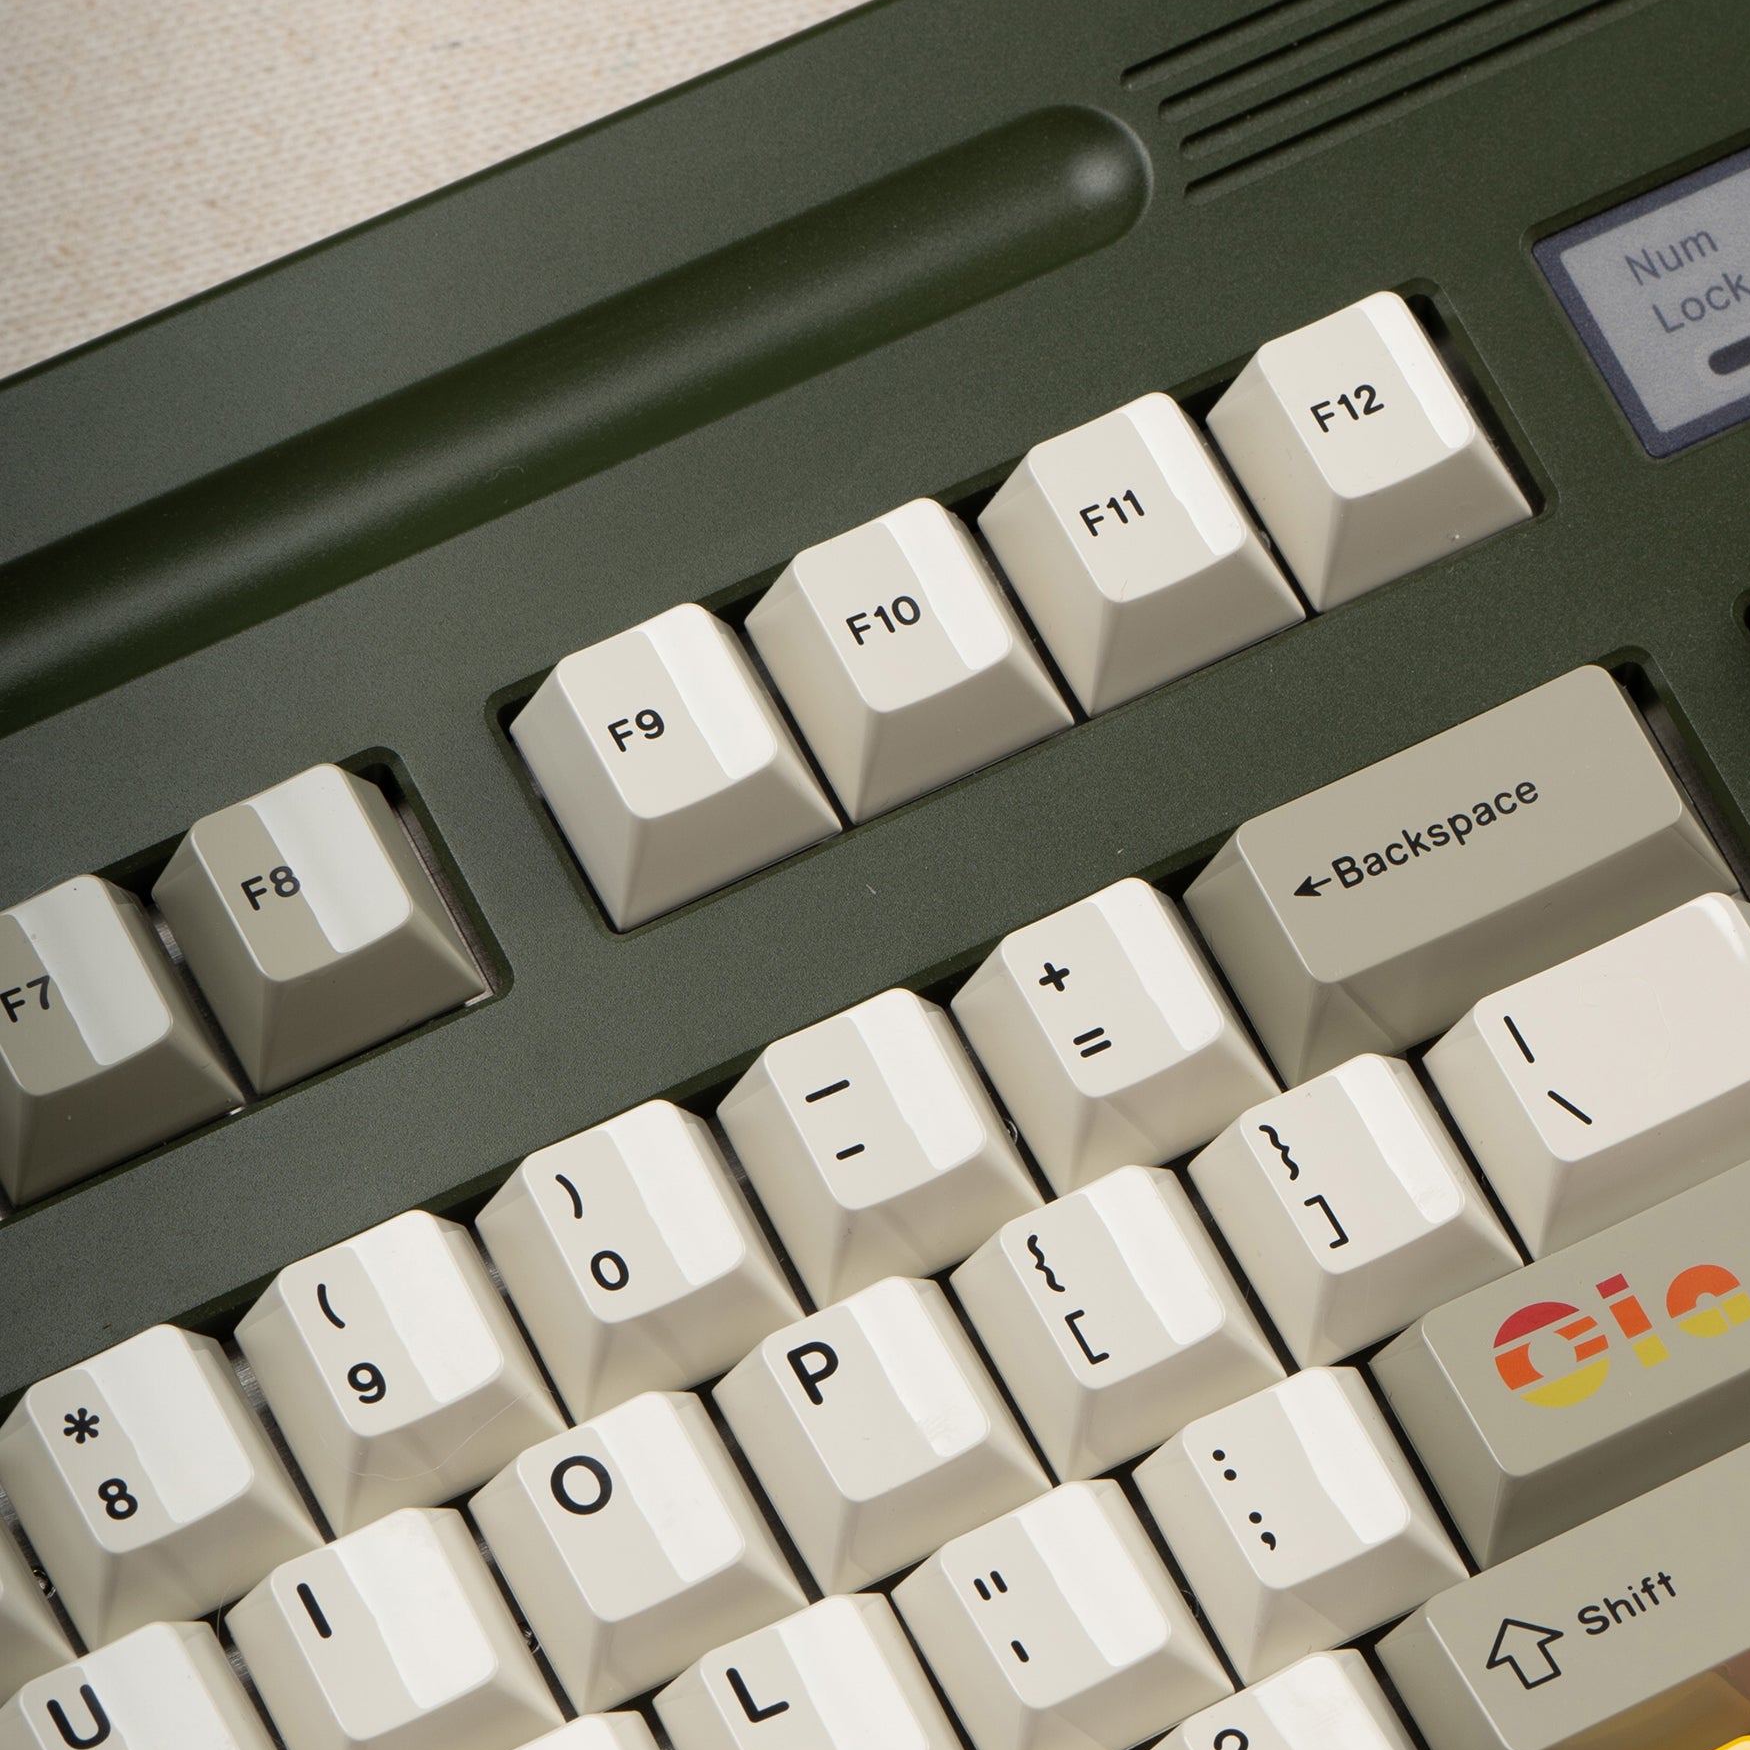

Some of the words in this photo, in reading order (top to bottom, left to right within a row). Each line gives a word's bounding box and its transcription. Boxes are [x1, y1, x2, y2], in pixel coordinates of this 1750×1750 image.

[1625, 227, 1721, 287] Num
[1310, 384, 1385, 433] F12
[1079, 489, 1145, 537] F11
[845, 595, 921, 646] F10
[607, 708, 665, 753] F9
[1331, 778, 1541, 890] Backspace
[240, 865, 301, 912] F8
[0, 975, 50, 1024] F7
[1038, 962, 1070, 992] +
[1072, 1027, 1112, 1059] =
[555, 1173, 583, 1220] )
[1303, 1194, 1349, 1249] ]
[590, 1250, 630, 1292] 0
[316, 1283, 346, 1330] (
[1064, 1309, 1110, 1365] [
[347, 1362, 387, 1405] 9
[786, 1341, 839, 1406] P
[550, 1455, 613, 1516] O
[1212, 1449, 1237, 1482] :
[97, 1477, 138, 1521] 8
[1248, 1511, 1277, 1551] ;
[296, 1582, 333, 1639] I
[1577, 1571, 1677, 1636] Shift
[46, 1684, 111, 1750] U
[725, 1667, 790, 1724] L
